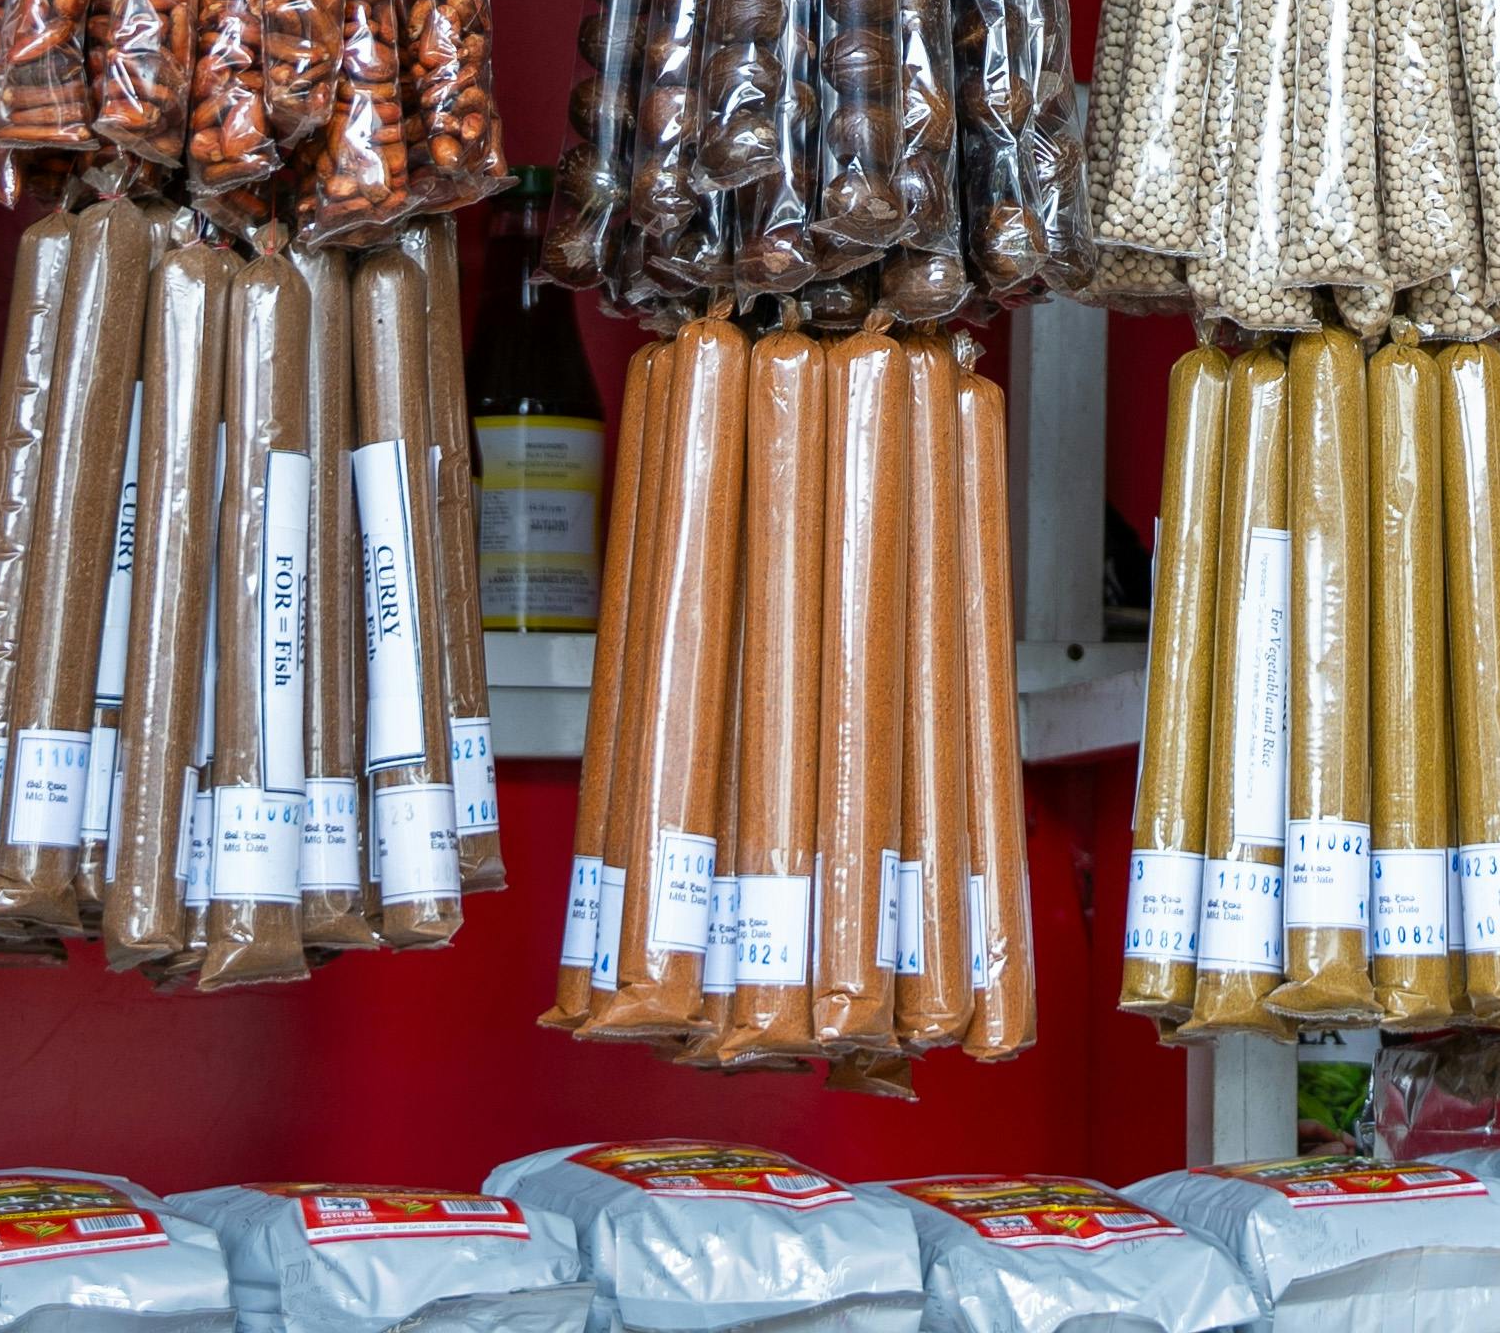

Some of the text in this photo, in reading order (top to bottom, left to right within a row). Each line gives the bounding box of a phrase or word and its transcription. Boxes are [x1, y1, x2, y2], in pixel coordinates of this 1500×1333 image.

[116, 482, 137, 574] CURRY
[377, 545, 402, 638] CURRY
[275, 555, 293, 687] FOR Fish
[1262, 608, 1283, 767] For Vegetable and Rice
[49, 793, 68, 803] Date
[246, 844, 268, 853] Date
[327, 836, 346, 844] Date
[750, 929, 771, 940] Date
